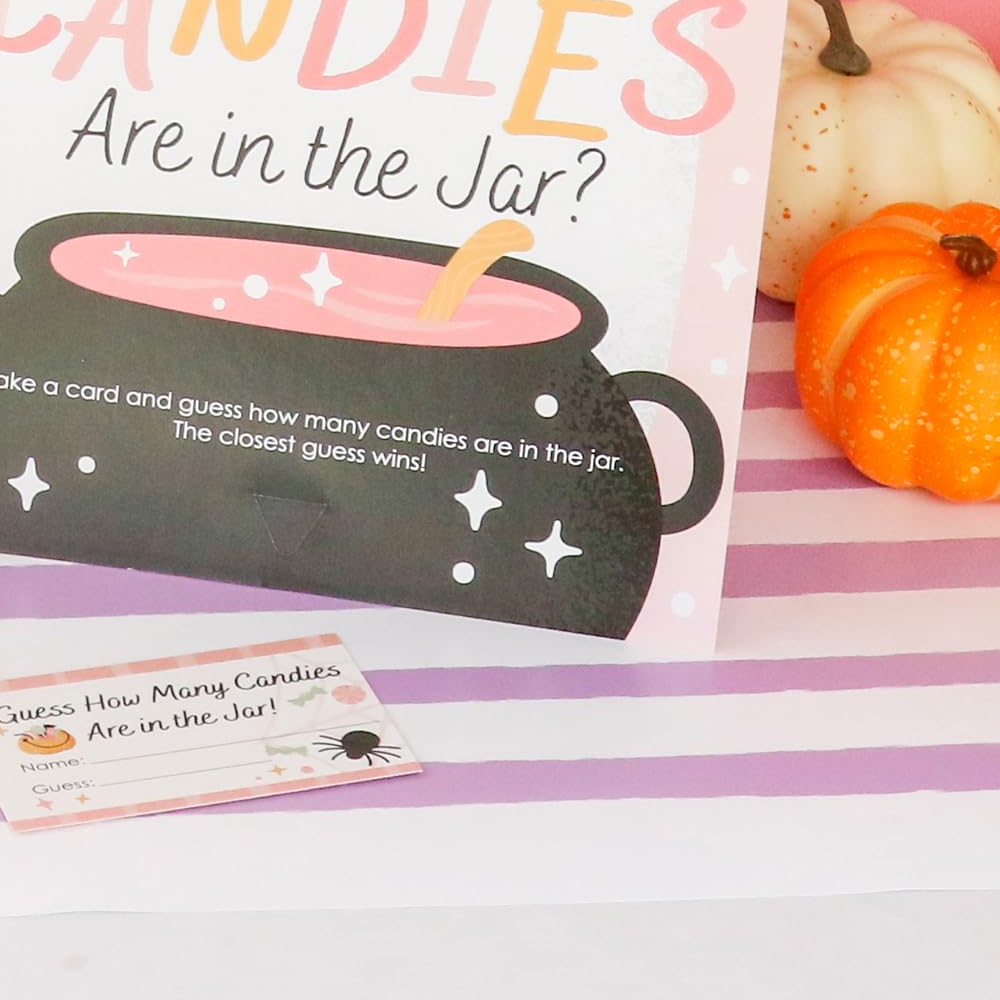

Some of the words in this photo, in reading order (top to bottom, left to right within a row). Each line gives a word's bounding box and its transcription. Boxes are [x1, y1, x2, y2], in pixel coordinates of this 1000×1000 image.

[66, 87, 193, 174] Are
[211, 111, 285, 185] in
[307, 117, 419, 201] the
[437, 135, 606, 223] Jar?
[43, 379, 58, 396] a
[65, 383, 119, 404] card
[126, 389, 172, 410] and
[178, 397, 243, 419] guess
[249, 402, 298, 426] how
[304, 413, 370, 440] many
[376, 423, 467, 450] candies
[474, 438, 512, 456] are
[519, 439, 538, 460] in
[546, 443, 583, 466] the
[587, 449, 625, 473] jar.
[173, 420, 212, 443] The
[219, 428, 296, 453] closest
[302, 439, 366, 462] guess
[372, 449, 427, 472] wins!
[85, 692, 142, 713] How
[152, 680, 230, 702] Many
[234, 663, 342, 691] Candies
[87, 722, 138, 742] Are
[139, 718, 171, 734] in
[173, 708, 219, 728] the
[223, 697, 278, 722] Jar!
[20, 756, 87, 773] Name:
[32, 777, 96, 796] Guess:
